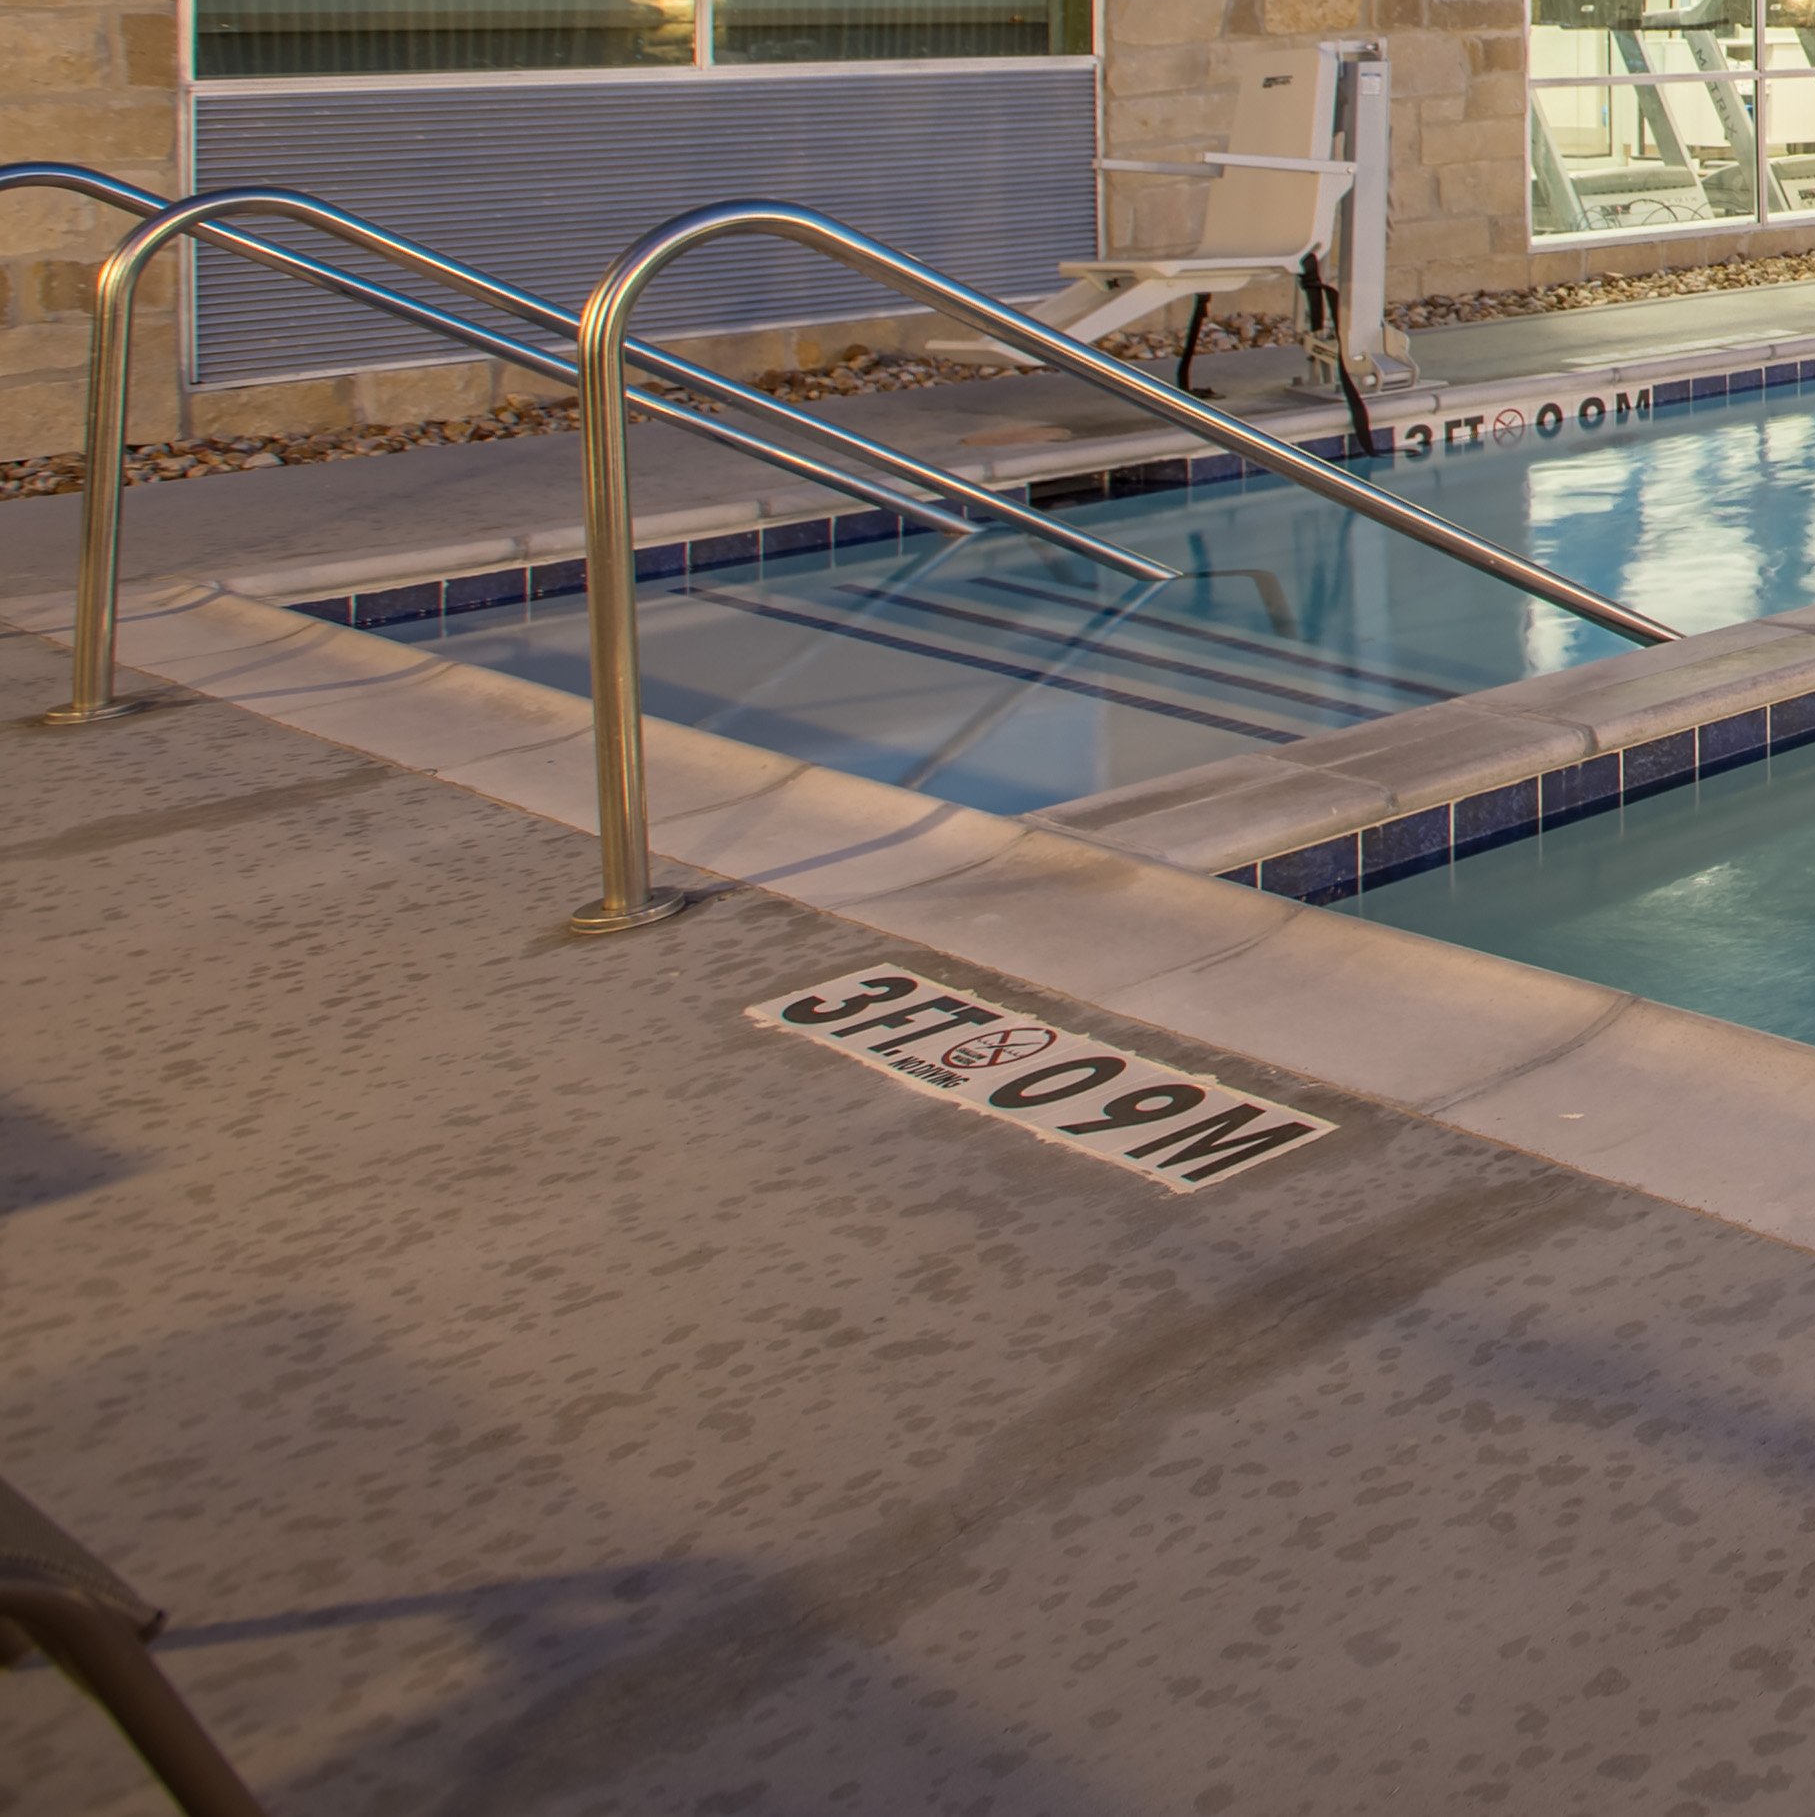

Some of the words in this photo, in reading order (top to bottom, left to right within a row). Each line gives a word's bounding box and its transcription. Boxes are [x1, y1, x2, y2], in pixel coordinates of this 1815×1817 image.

[1696, 48, 1738, 138] MTRIX
[888, 1056, 926, 1071] NO
[907, 1063, 970, 1089] DIVING
